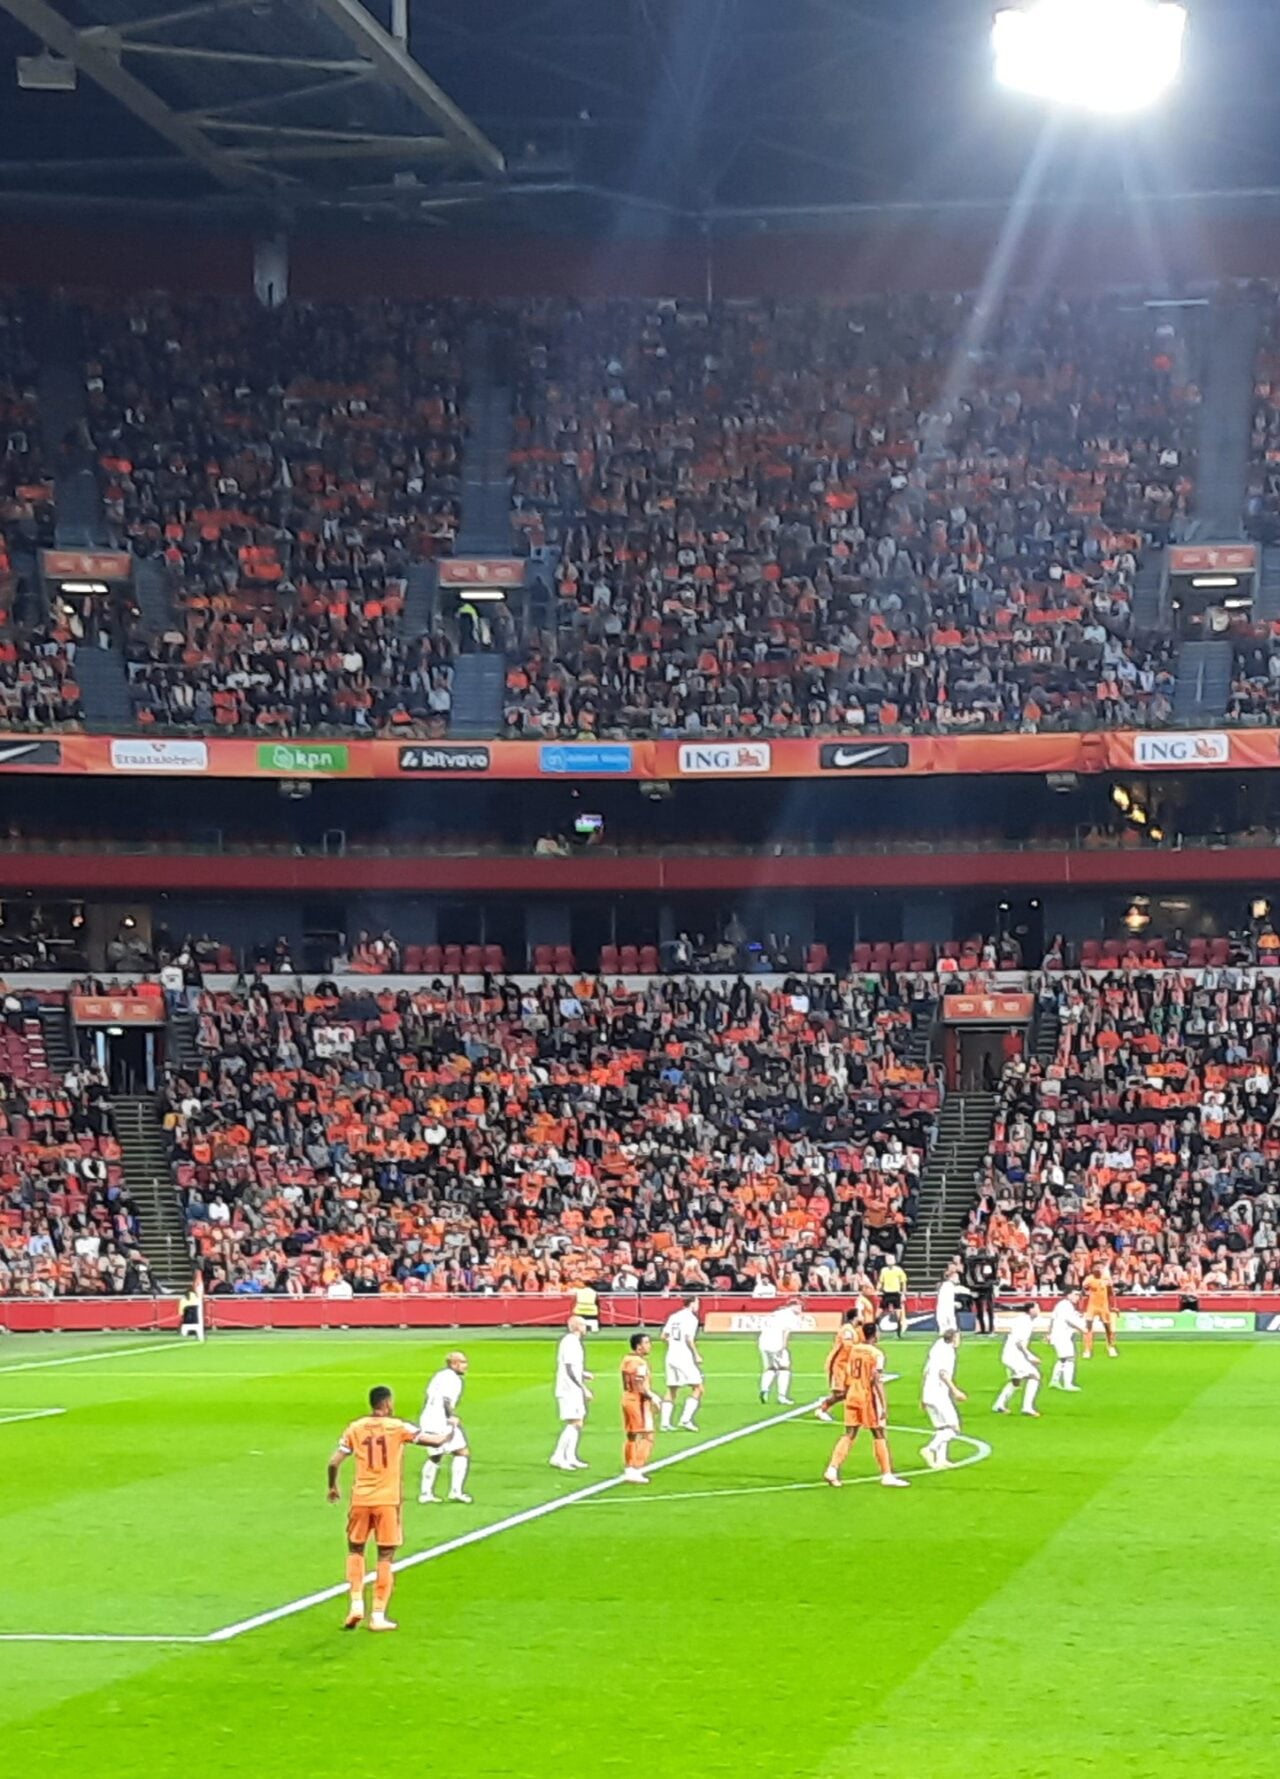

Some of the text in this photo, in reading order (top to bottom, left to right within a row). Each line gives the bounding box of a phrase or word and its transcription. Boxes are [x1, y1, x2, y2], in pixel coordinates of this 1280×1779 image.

[296, 750, 332, 769] kpn
[422, 751, 488, 767] bitvavo
[686, 751, 730, 768] ING
[1141, 742, 1187, 760] ING
[362, 1436, 387, 1469] 11
